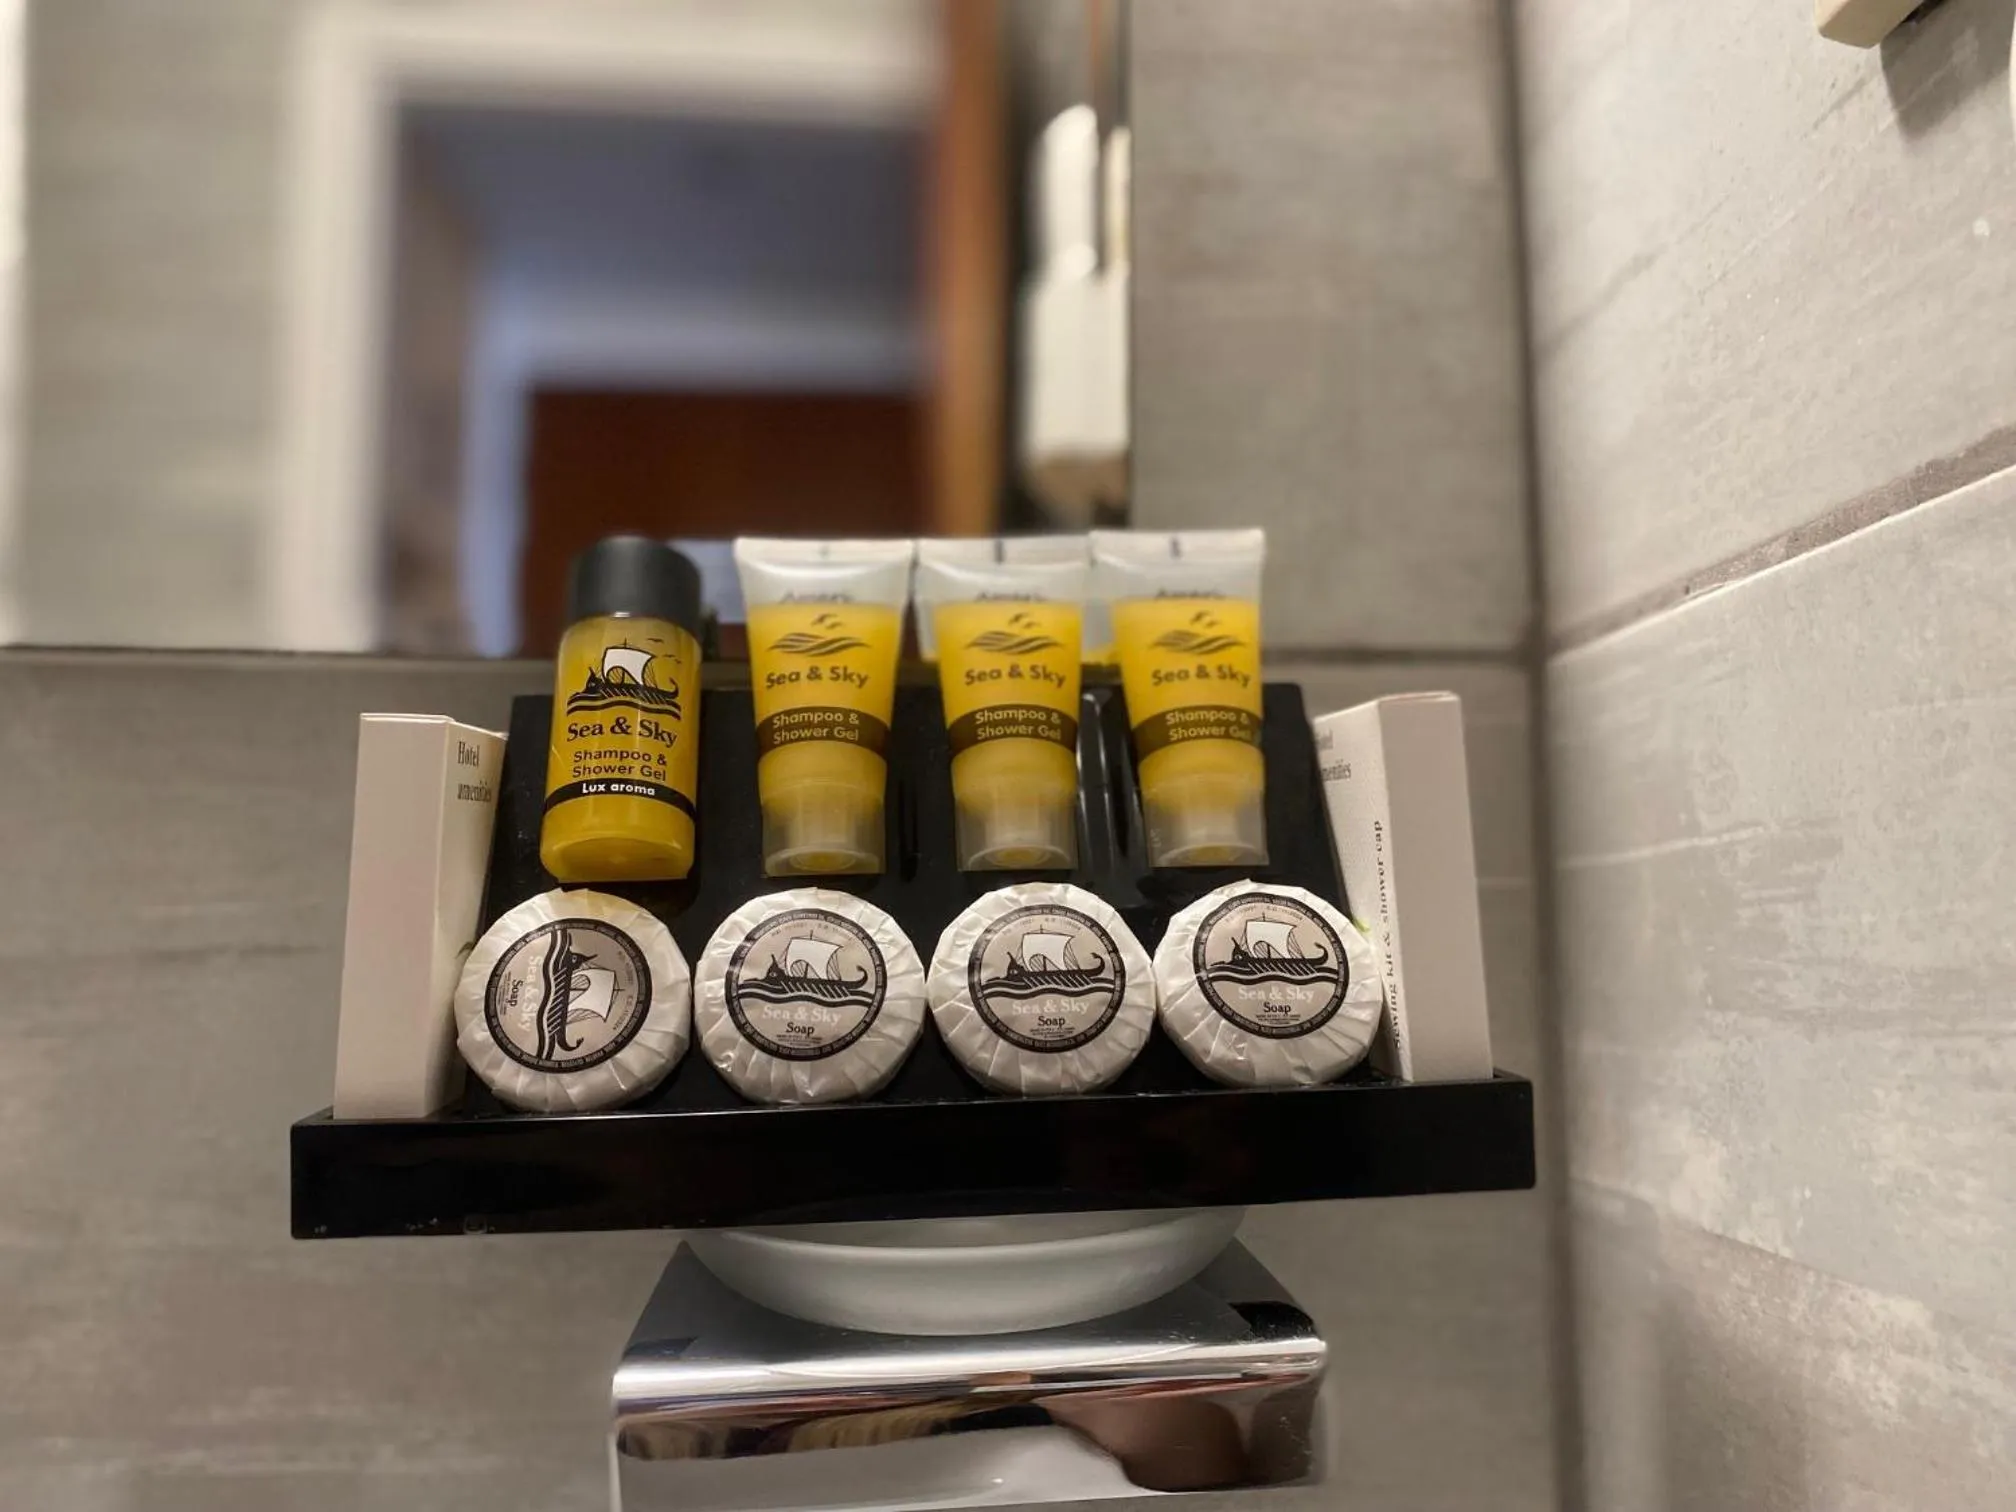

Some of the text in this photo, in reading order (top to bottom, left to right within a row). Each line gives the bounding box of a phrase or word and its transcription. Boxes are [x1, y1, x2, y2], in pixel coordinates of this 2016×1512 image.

[766, 666, 869, 689] Sea & Sky
[964, 664, 1066, 688] Sea & Sky
[1151, 664, 1250, 688] Sea & Sky
[772, 710, 860, 728] Shampoo &
[975, 709, 1062, 725] Shampoo &
[1165, 710, 1250, 726] Shampoo &
[567, 716, 677, 748] Sea & Sky
[773, 726, 860, 745] Shower Gel
[977, 724, 1062, 741] Shower Gel
[1168, 726, 1226, 742] Shower
[457, 740, 480, 767] Hotel
[574, 749, 667, 766] Shampoo &
[572, 764, 666, 781] Shower Gel
[582, 782, 656, 796] Lux aroma
[1373, 820, 1383, 852] cap
[1377, 857, 1388, 923] shower
[1385, 953, 1394, 977] kit
[507, 979, 524, 1008] Soap
[518, 955, 544, 1032] Sea & Sky
[1238, 985, 1315, 1002] Sea & Sky
[762, 1005, 841, 1025] Sea & Sky
[1012, 999, 1089, 1015] Sea & Sky
[1263, 1002, 1292, 1017] Soap
[785, 1021, 815, 1037] Soap
[1037, 1015, 1066, 1029] Soap
